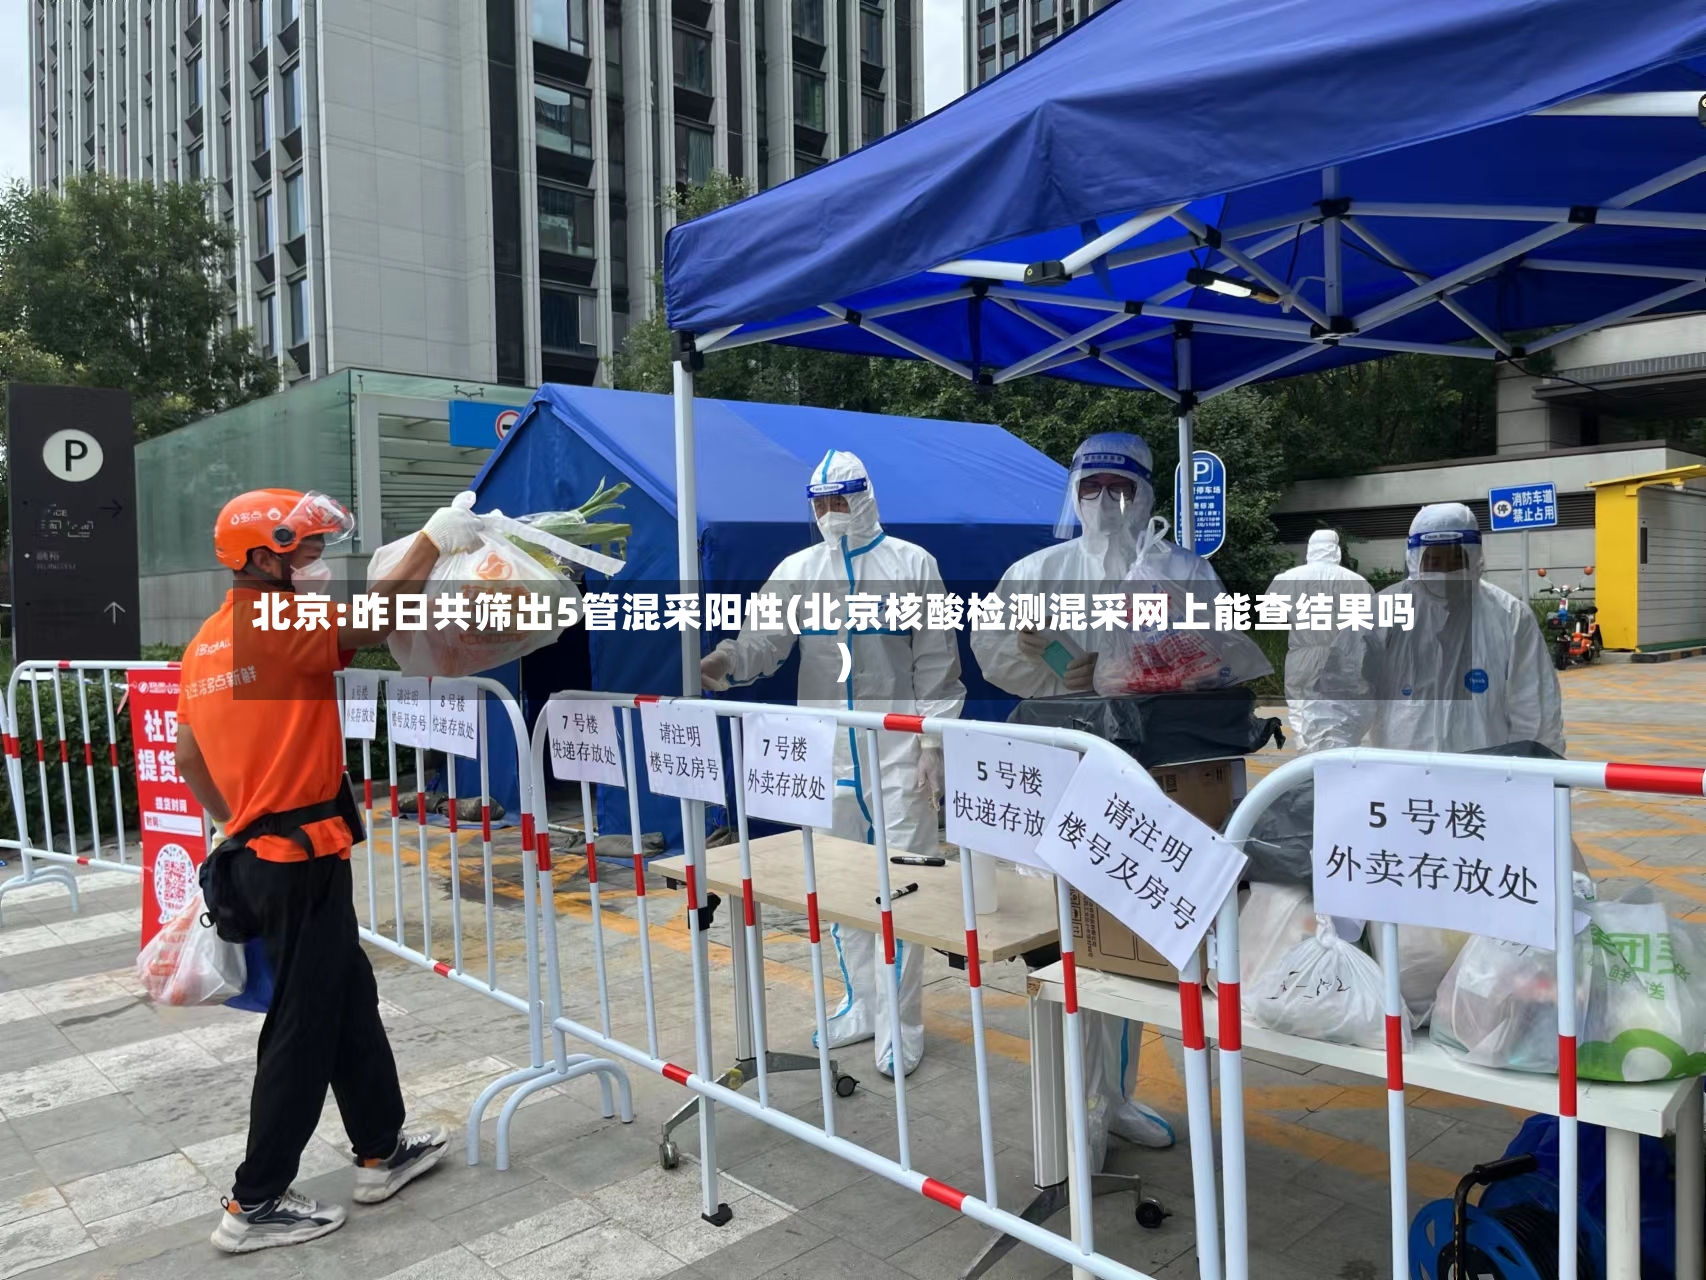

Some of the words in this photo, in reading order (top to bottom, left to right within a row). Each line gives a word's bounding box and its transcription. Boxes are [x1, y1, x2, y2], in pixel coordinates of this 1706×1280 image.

[65, 440, 88, 472] P
[1193, 462, 1209, 481] P
[1512, 490, 1554, 505] 消防车道
[1513, 506, 1554, 523] 禁止占用
[397, 688, 419, 707] 请注明
[440, 693, 465, 713] 8号楼
[432, 715, 475, 740] 快递存放处
[562, 713, 598, 735] 7号楼
[659, 721, 701, 748] 请注明
[552, 739, 617, 766] 快递存放处
[762, 735, 808, 762] 7号楼
[138, 748, 186, 783] 提货
[649, 750, 719, 781] 楼号及房号
[976, 760, 1043, 797] 5号楼
[747, 768, 826, 801] 外卖存放处
[953, 790, 1045, 838] 快递存放
[1369, 798, 1487, 841] 5号楼
[1103, 792, 1194, 873] 请注明
[1057, 811, 1196, 930] 楼号及房号
[1326, 845, 1539, 905] 外卖存放处
